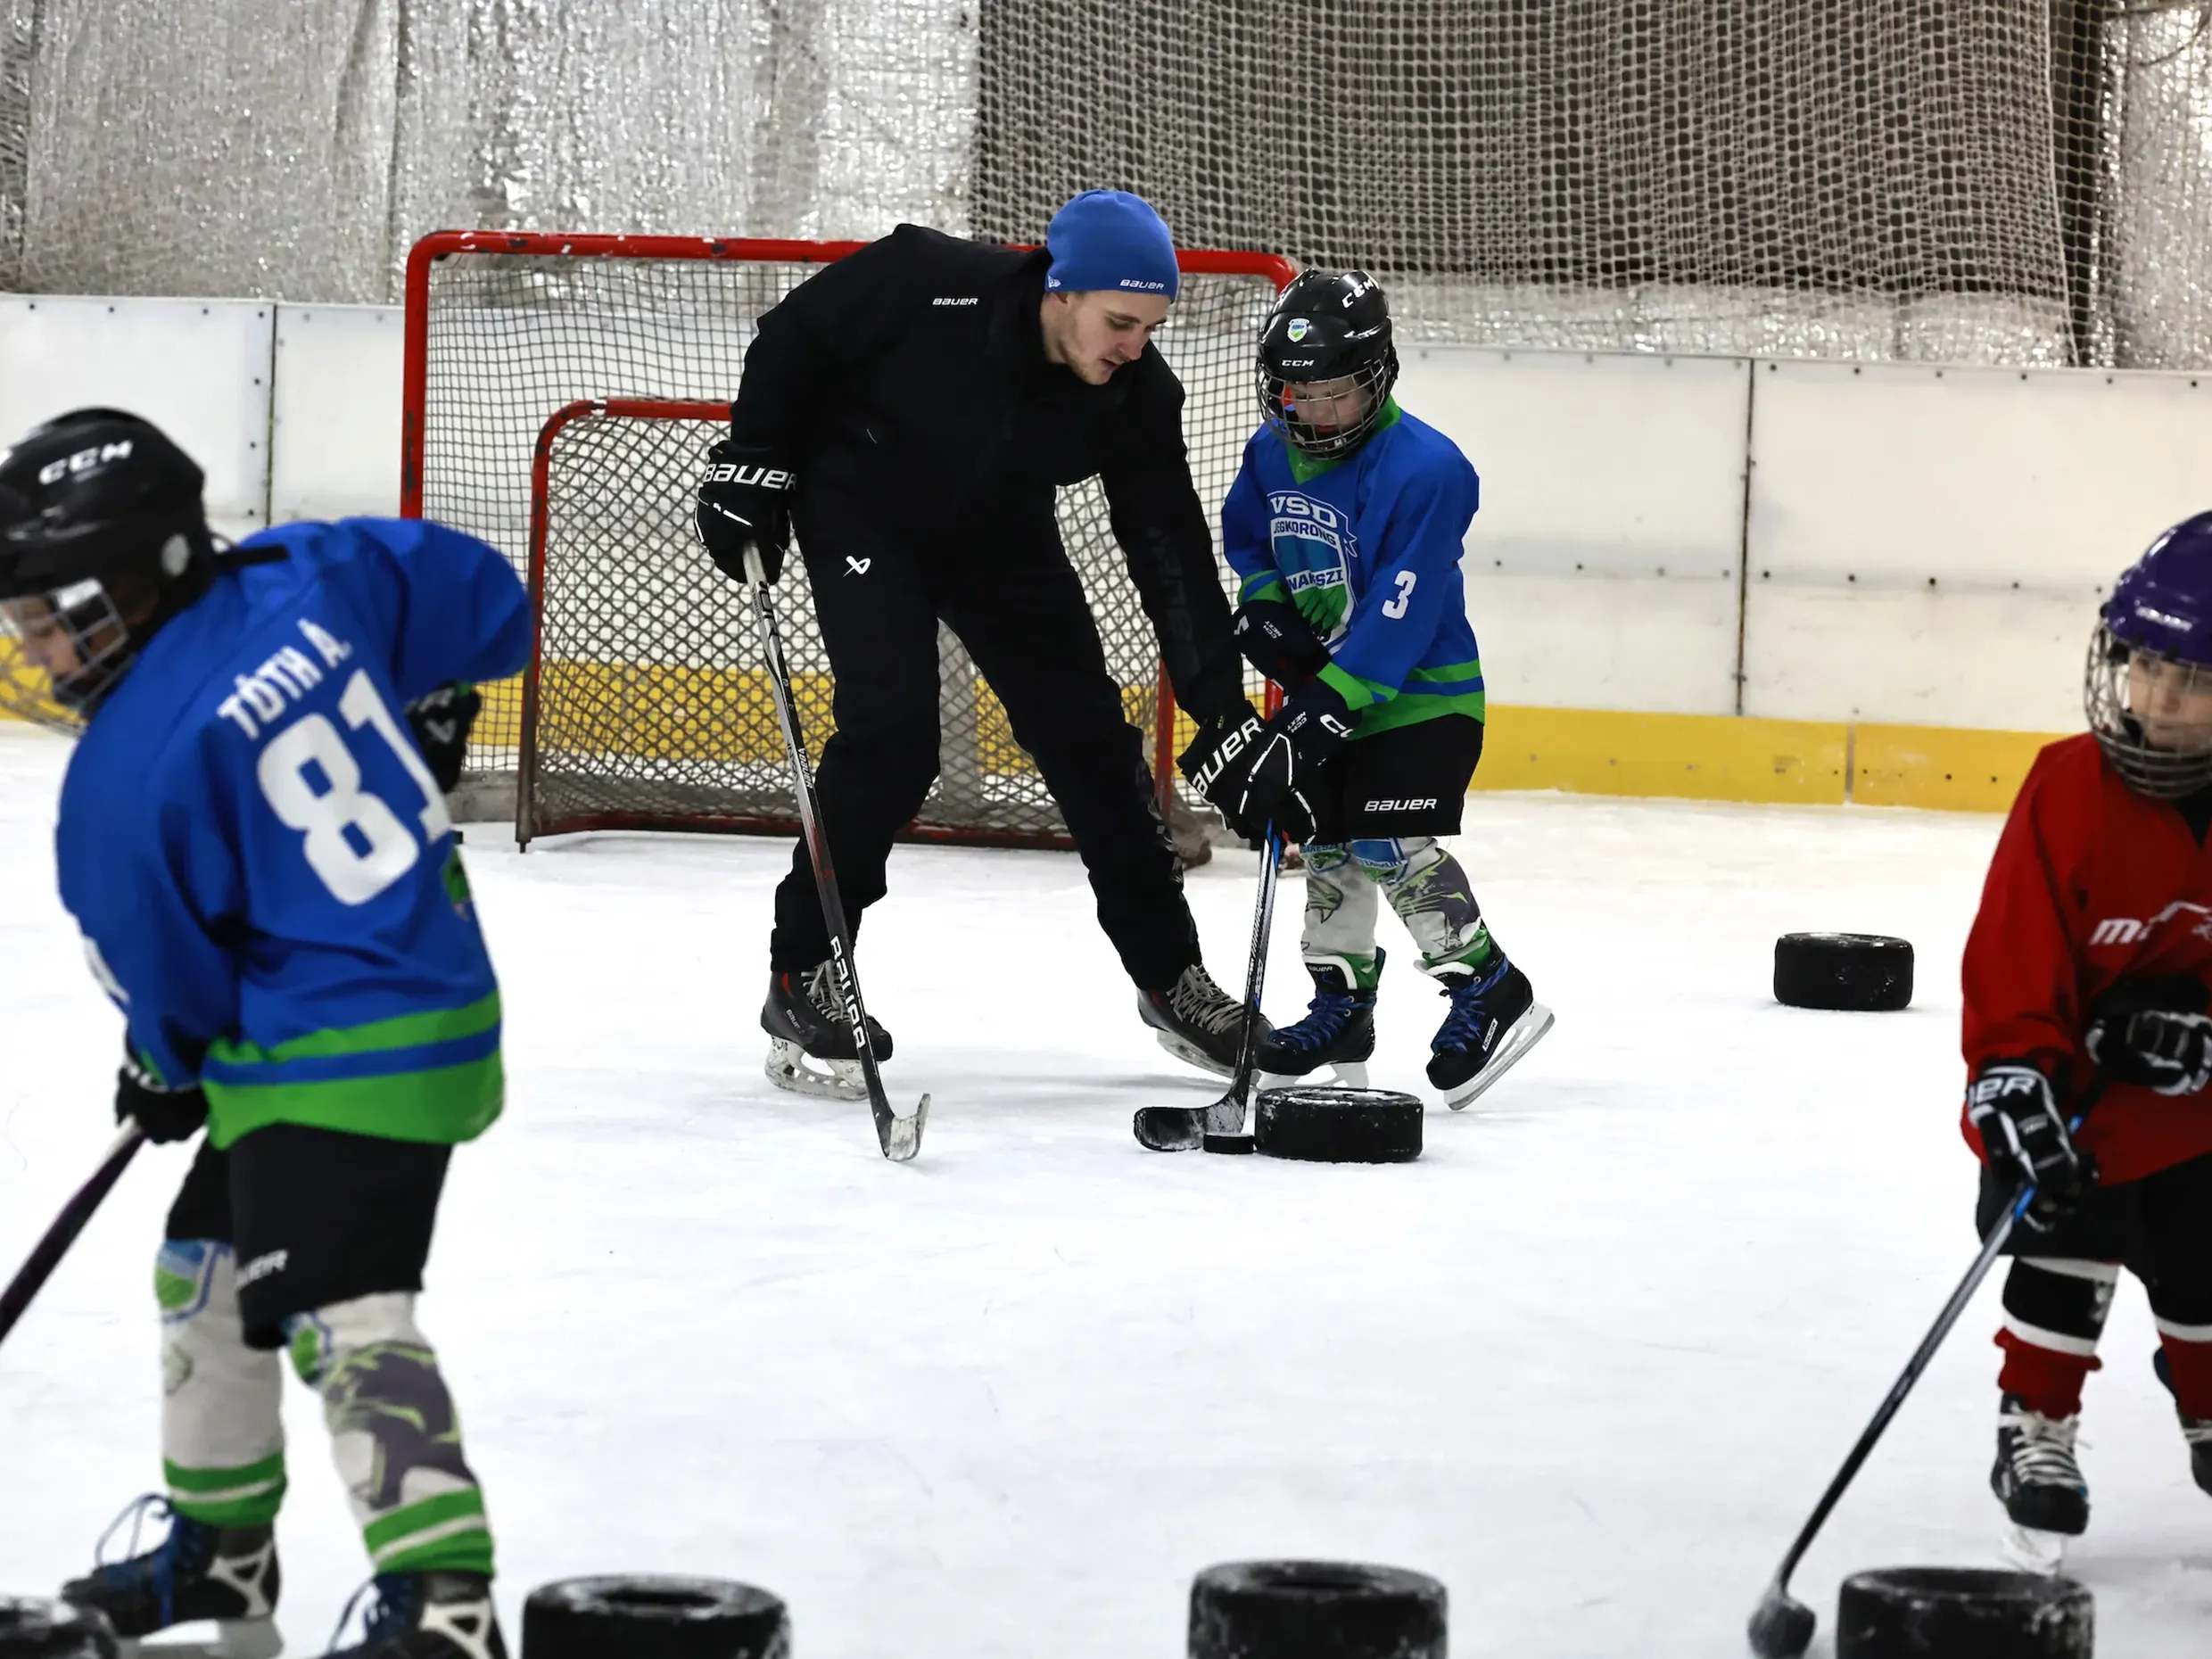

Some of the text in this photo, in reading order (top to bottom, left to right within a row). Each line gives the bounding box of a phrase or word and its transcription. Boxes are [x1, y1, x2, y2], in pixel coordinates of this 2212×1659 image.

[1119, 279, 1164, 290] BAUER
[1341, 278, 1374, 308] CCM
[38, 440, 134, 485] CCM
[702, 463, 796, 491] BAUER
[1270, 496, 1338, 528] VSD
[1382, 570, 1416, 620] 3
[217, 646, 324, 740] TÓTH
[1192, 716, 1265, 796] AUER
[257, 668, 455, 906] 81
[1364, 798, 1437, 812] BAUER
